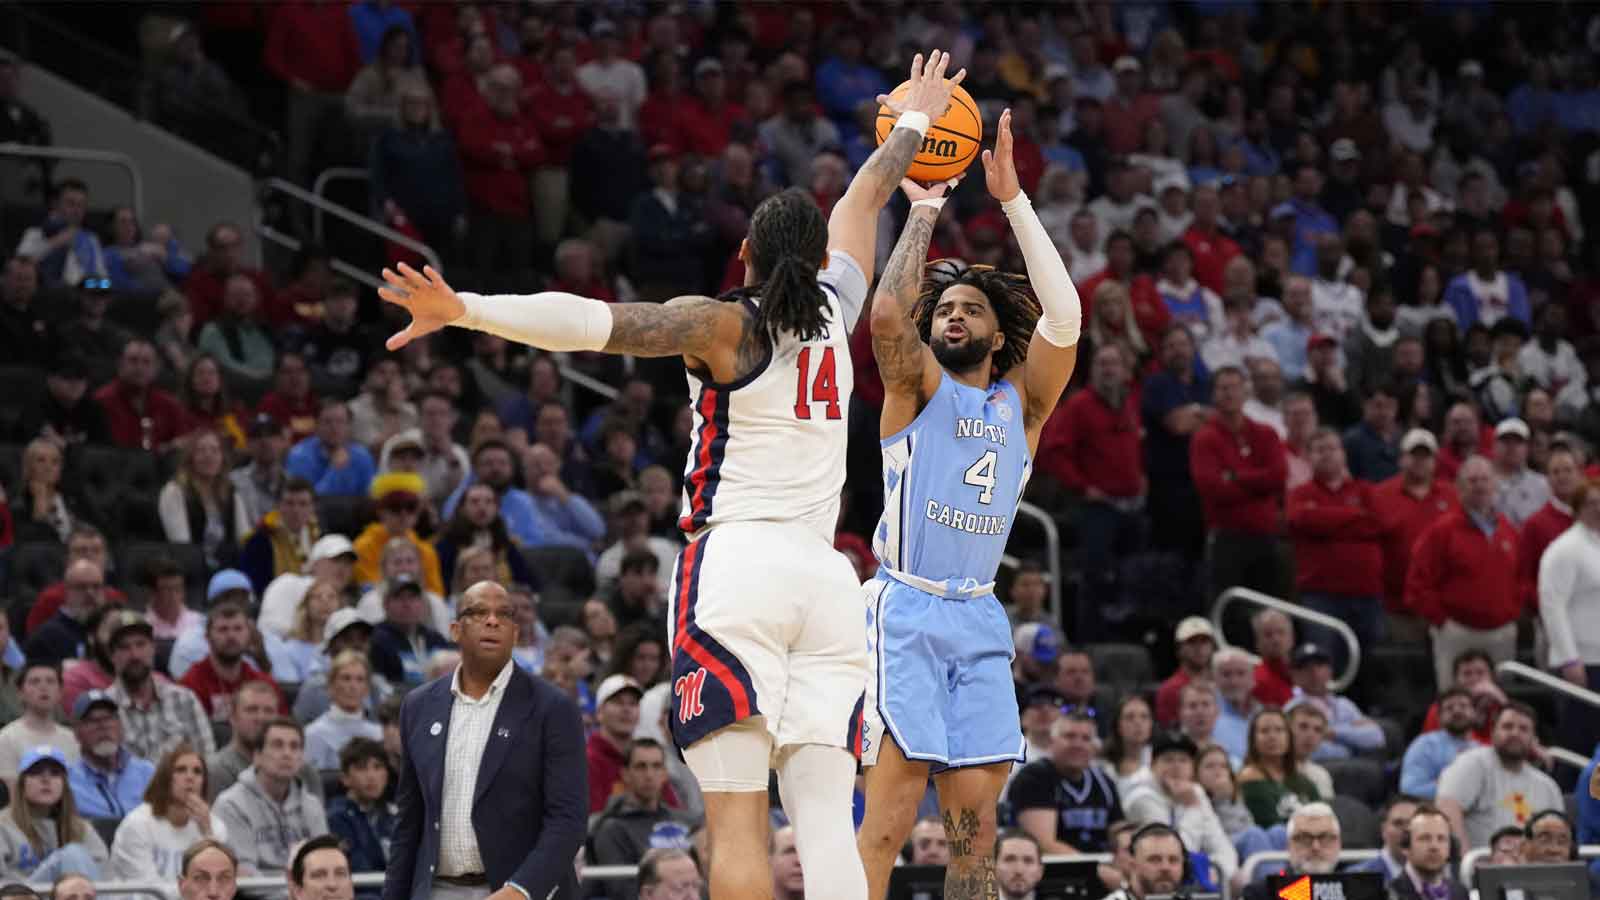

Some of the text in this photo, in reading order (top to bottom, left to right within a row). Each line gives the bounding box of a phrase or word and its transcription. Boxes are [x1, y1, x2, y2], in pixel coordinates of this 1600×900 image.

[793, 346, 842, 420] 14
[956, 417, 1008, 447] NOTH
[963, 449, 998, 505] 4
